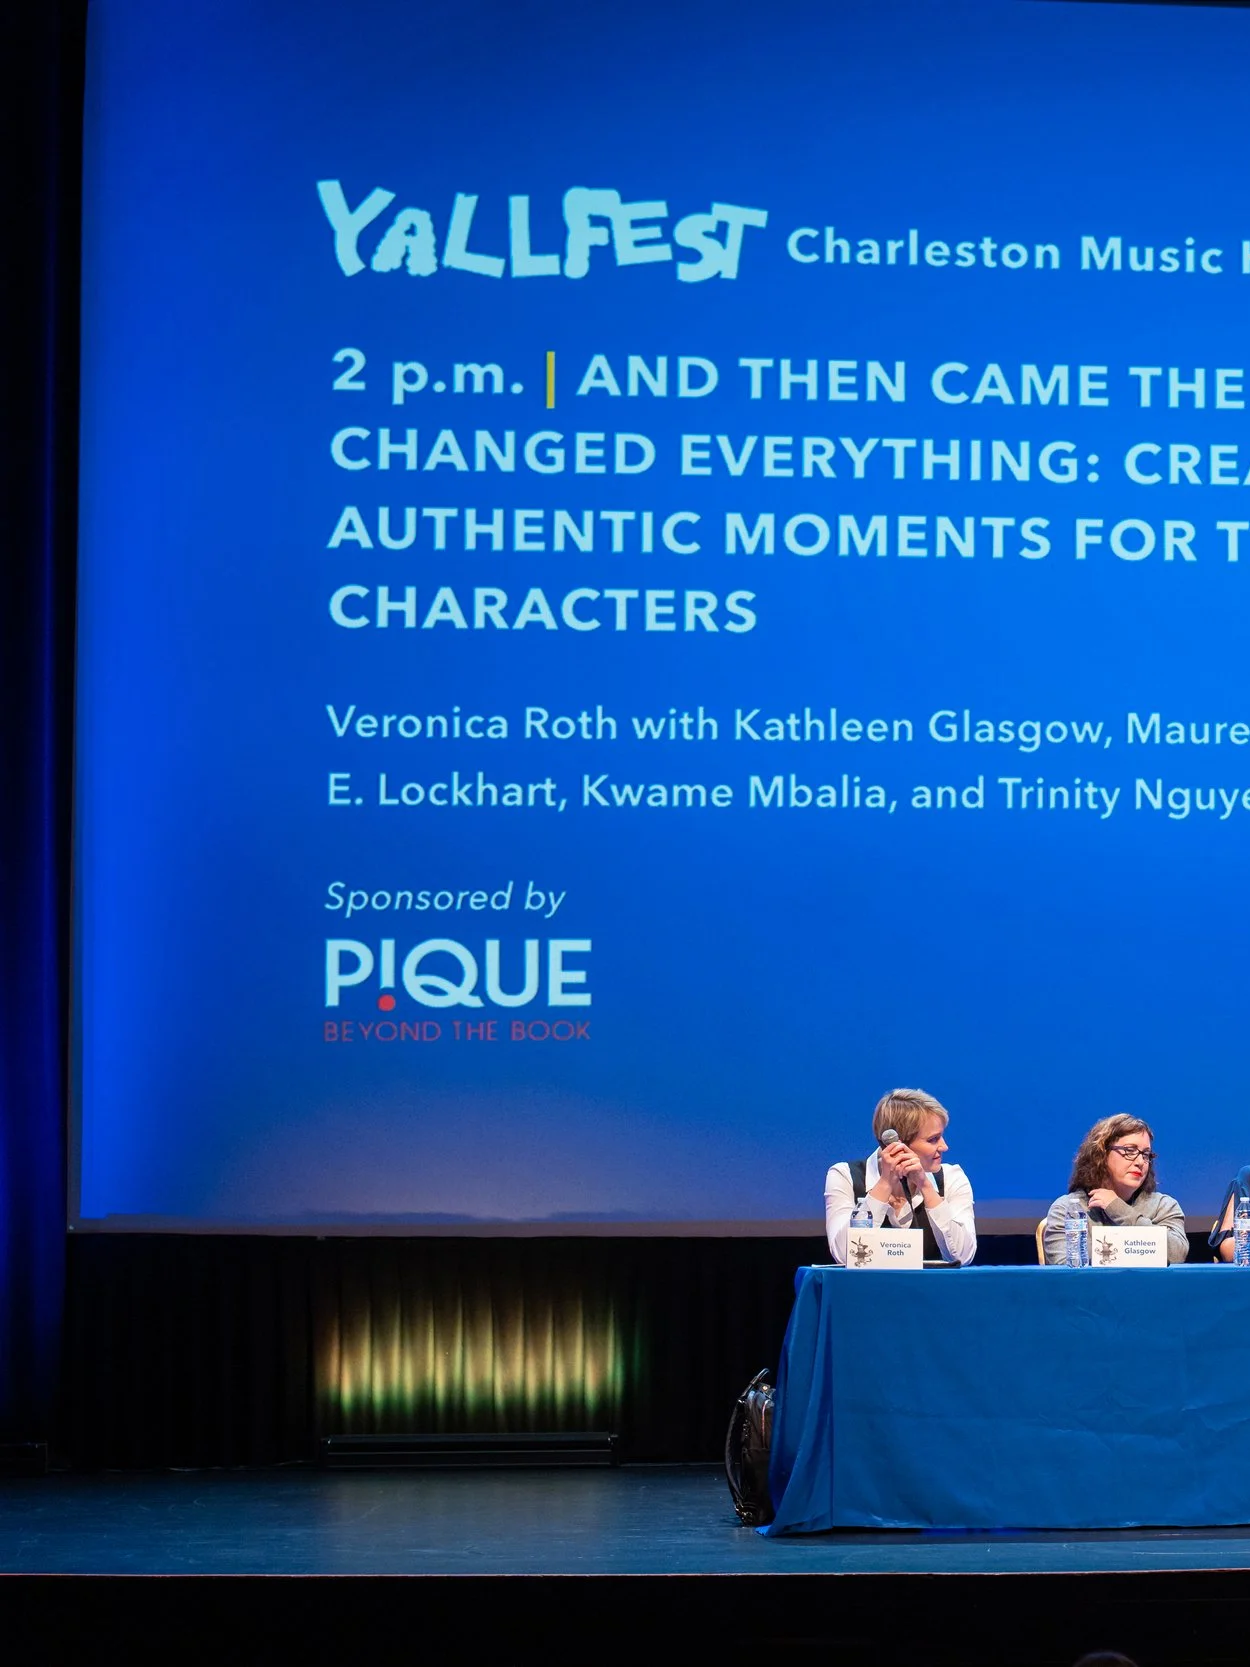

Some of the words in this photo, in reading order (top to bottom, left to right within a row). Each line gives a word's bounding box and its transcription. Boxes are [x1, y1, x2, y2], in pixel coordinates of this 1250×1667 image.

[316, 179, 768, 283] YALLFEST
[787, 226, 1060, 270] Charleston
[1081, 236, 1223, 275] Music
[332, 347, 366, 391] 2
[392, 361, 524, 405] p.m.
[576, 354, 718, 398] AND
[739, 358, 905, 403] THEN
[931, 362, 1109, 407] CAME
[1129, 367, 1245, 409] THE
[330, 426, 656, 475] CHANGED
[681, 434, 1100, 483] EVERYTHING:
[327, 506, 700, 555] AUTHENTIC
[725, 513, 1050, 560] MOMENTS
[1076, 519, 1197, 562] FOR
[329, 584, 757, 634] CHARACTERS
[326, 705, 508, 740] Veronica
[525, 705, 617, 740] Roth
[632, 706, 718, 741] with
[735, 707, 913, 742] Kathleen
[929, 709, 1112, 753] Glasgow,
[328, 773, 363, 806] E.
[379, 771, 568, 812] Lockhart,
[583, 775, 733, 808] Kwame
[749, 774, 898, 815] Mbalia,
[911, 775, 985, 809] and
[998, 778, 1121, 820] Trinity
[325, 881, 513, 918] Sponsored
[524, 881, 566, 918] by
[324, 1021, 442, 1042] BEYOND
[452, 1021, 498, 1041] THE
[511, 1020, 591, 1041] BOOK
[1124, 1247, 1156, 1255] Glasgow
